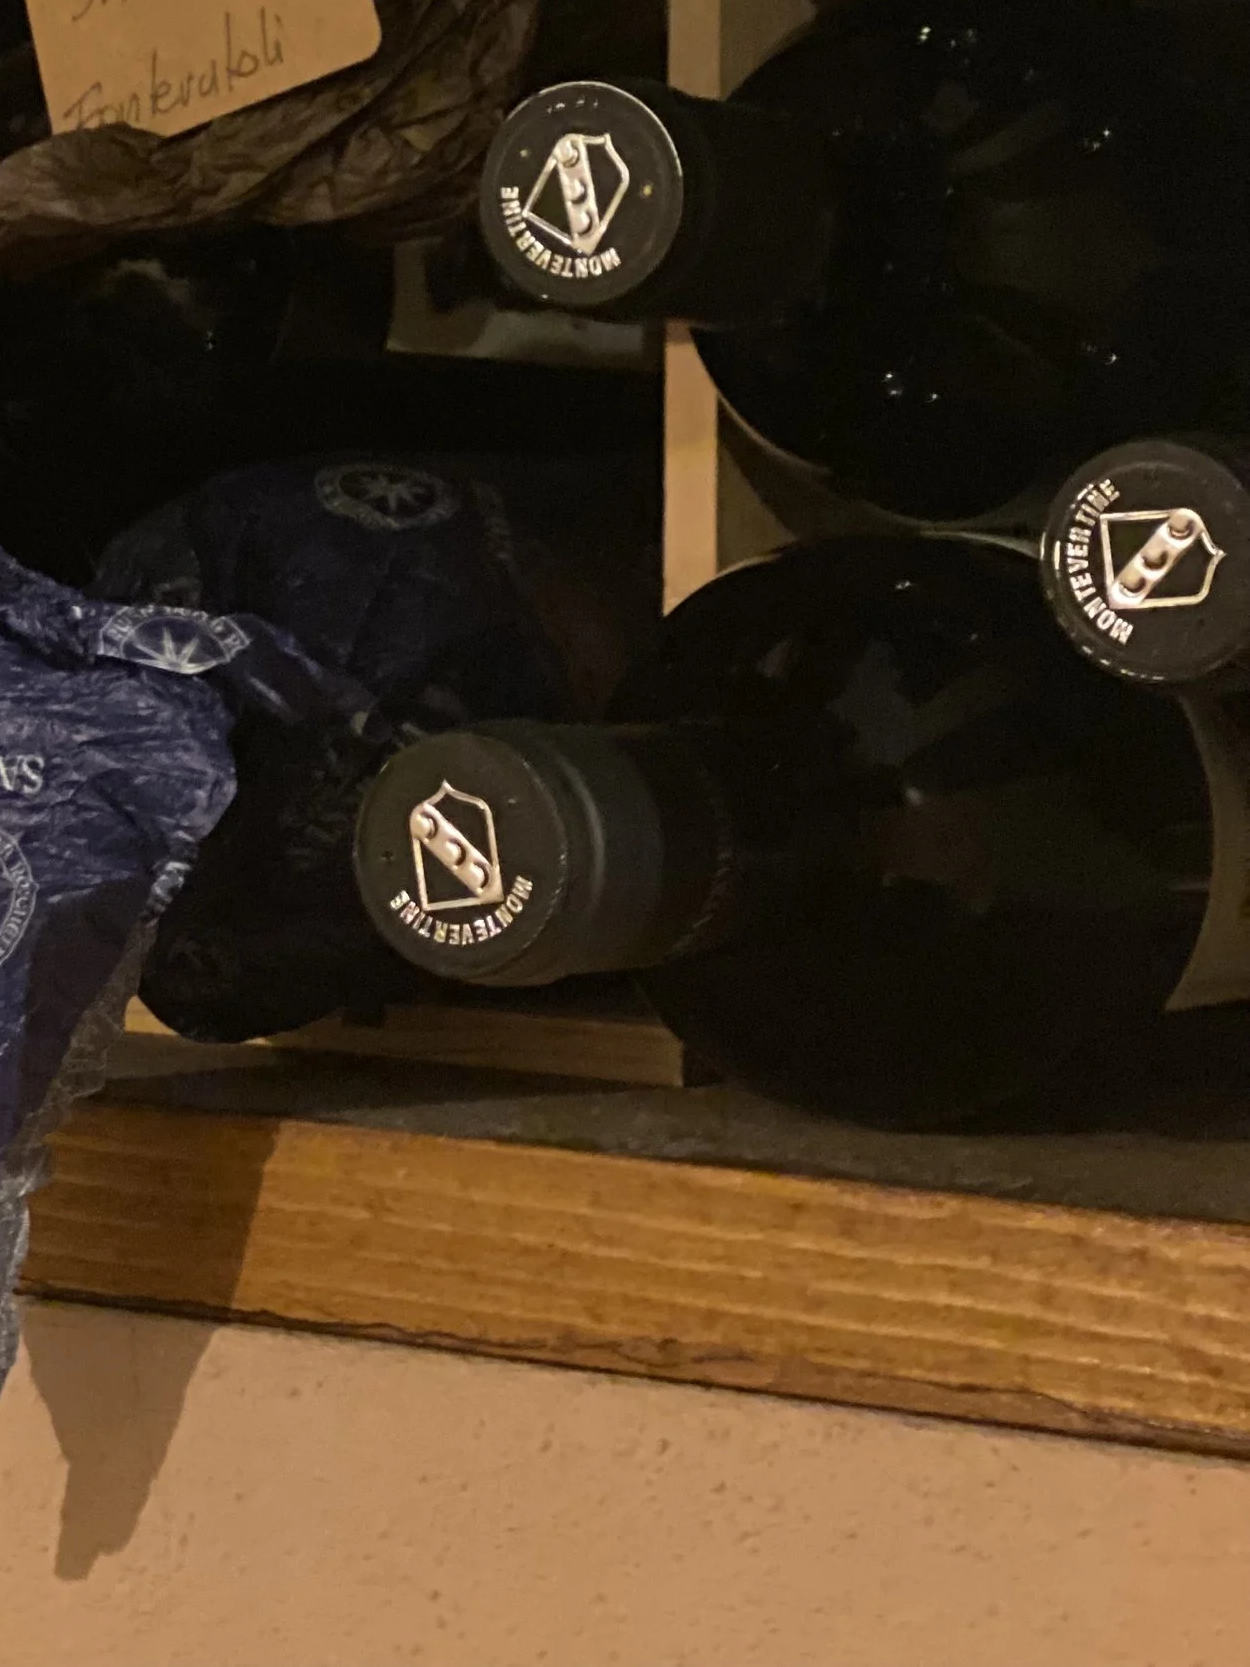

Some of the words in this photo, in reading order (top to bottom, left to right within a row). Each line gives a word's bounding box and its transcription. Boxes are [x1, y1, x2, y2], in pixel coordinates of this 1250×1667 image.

[500, 185, 623, 279] MONTEVERTINE
[1065, 477, 1135, 646] MONTEVERTINE
[389, 874, 534, 946] MONTEVERTINE
